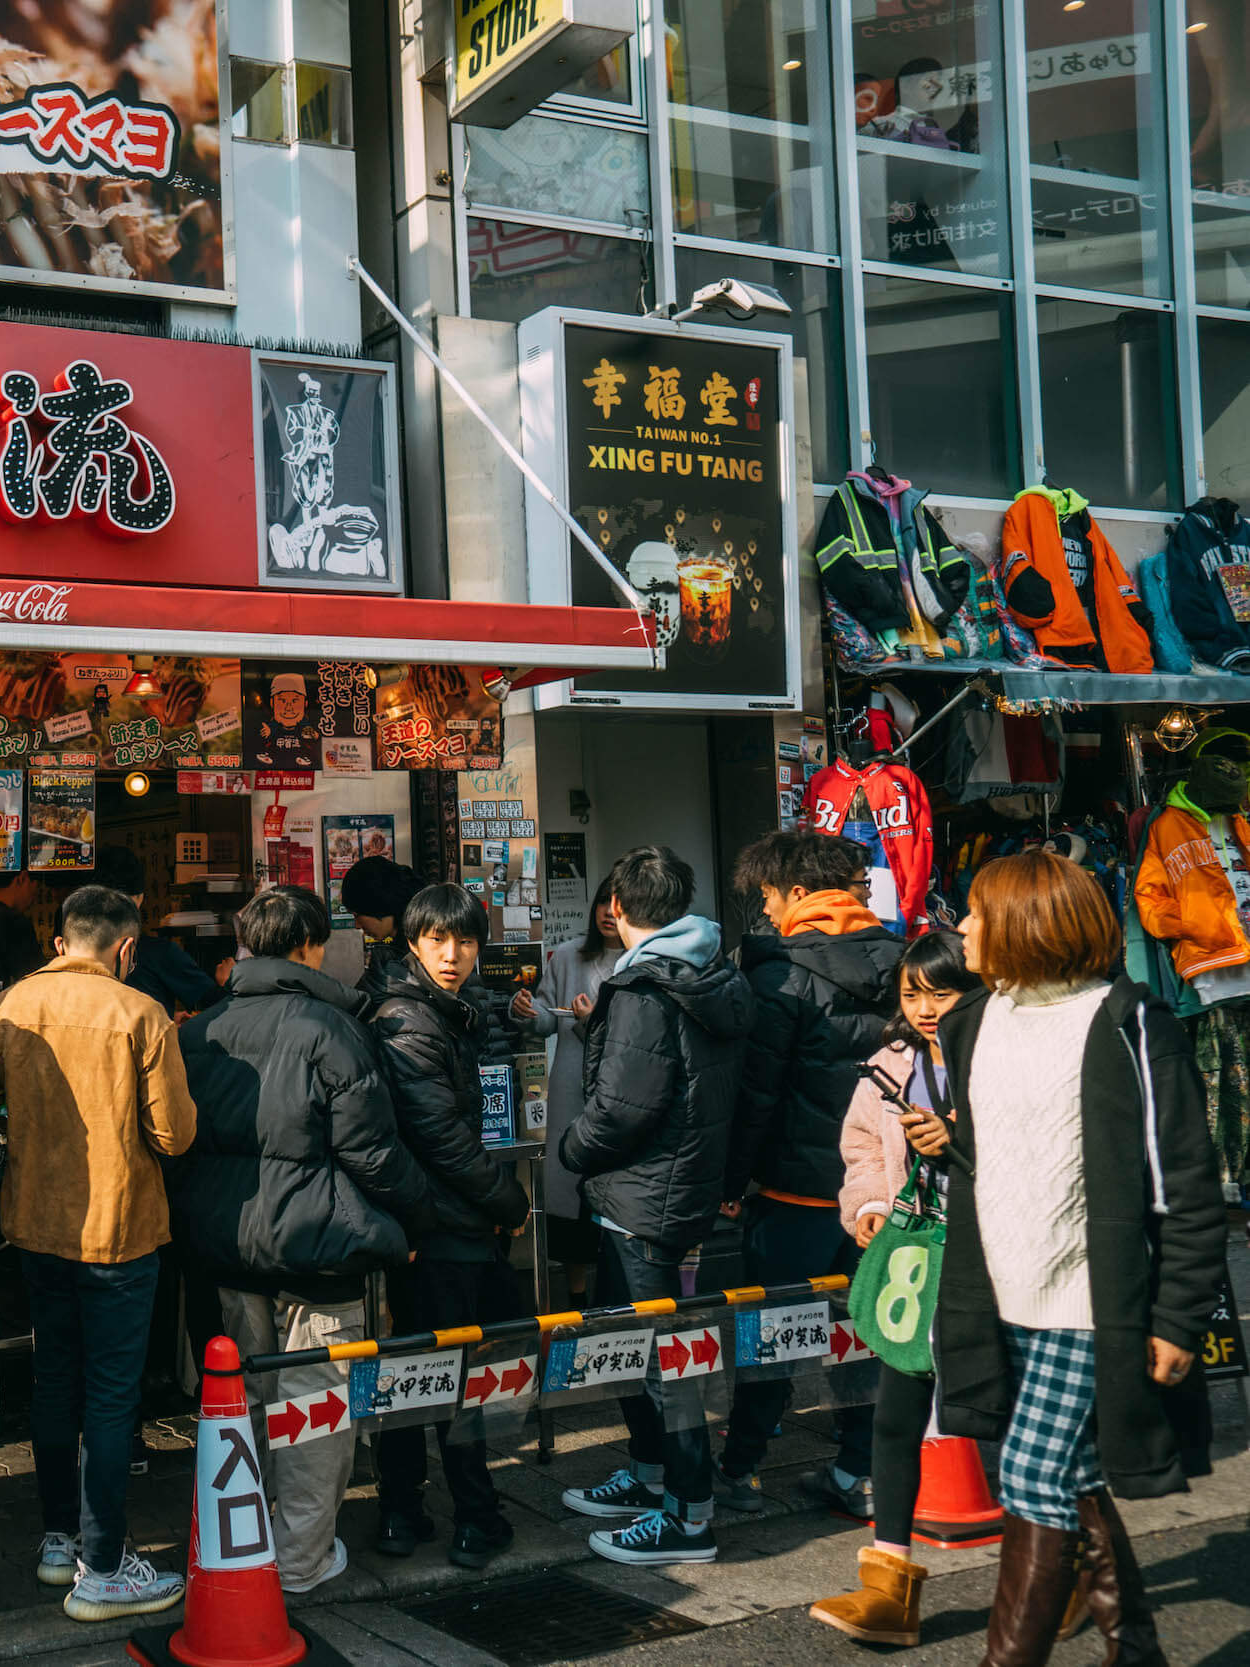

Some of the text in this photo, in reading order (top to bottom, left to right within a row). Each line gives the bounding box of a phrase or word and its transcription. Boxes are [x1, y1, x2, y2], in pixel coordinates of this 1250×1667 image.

[582, 358, 739, 427] 幸福堂
[635, 425, 722, 446] TAIWAN NO.1
[588, 445, 764, 483] XING FU TANG
[381, 717, 431, 745] 王道の
[61, 753, 96, 766] 550円
[114, 730, 199, 766] ねぎソース
[207, 754, 240, 767] 550円
[385, 733, 467, 768] ソースマヨ
[470, 757, 499, 769] 450円
[48, 858, 76, 867] 500円
[876, 1245, 929, 1344] 8
[780, 1324, 828, 1348] 甲賀流
[592, 1349, 645, 1374] 甲賀流
[399, 1373, 456, 1398] 甲賀流
